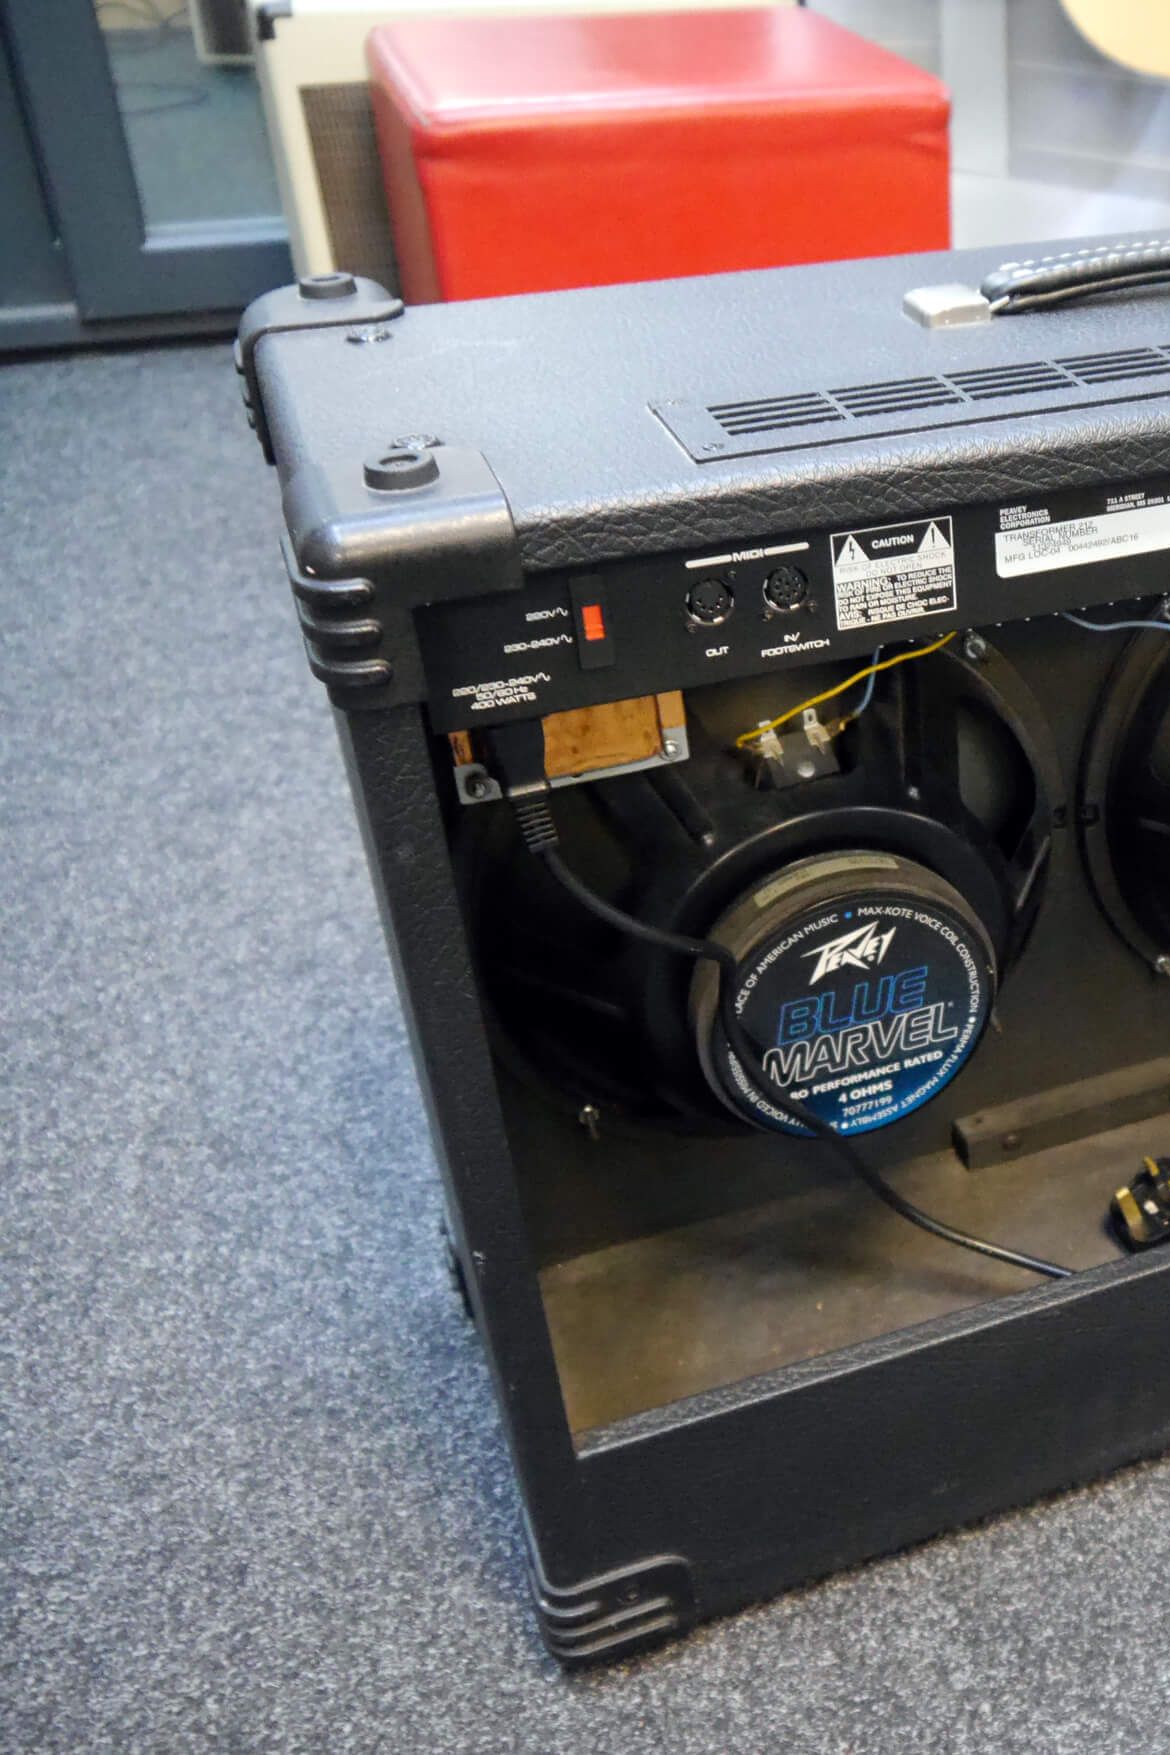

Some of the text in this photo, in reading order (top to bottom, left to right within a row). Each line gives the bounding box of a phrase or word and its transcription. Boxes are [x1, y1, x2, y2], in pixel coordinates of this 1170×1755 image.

[999, 505, 1027, 517] PEAVEY
[999, 509, 1050, 523] ELECTRONICS
[999, 516, 1051, 530] CORPORATION
[1003, 522, 1076, 542] TRANSFORMER
[1058, 526, 1098, 540] NUMBER
[871, 534, 915, 549] CAUTION
[731, 548, 764, 563] MIDI
[875, 557, 914, 569] ELECTRIC
[918, 551, 946, 561] SHOCK
[1003, 553, 1026, 564] MFG
[705, 646, 729, 658] OUT
[761, 638, 830, 658] FOOTSWITCH
[470, 692, 537, 710] 400 WATTS
[803, 914, 839, 935] MUSIC
[755, 930, 804, 975] AMERICAN
[800, 920, 897, 986] PEAVEY
[857, 906, 980, 1013] MAX-KOTE VOICE COIL CONSTRUCTION
[745, 973, 758, 988] OF
[778, 966, 929, 1046] BLUE
[762, 1002, 959, 1088] MARVEL
[812, 1062, 900, 1095] PERFORMANCE
[903, 1050, 943, 1069] RATED
[851, 1023, 975, 1128] PERMA FLUX MAGNET ASSEMBLY
[838, 1080, 893, 1104] 4 OHMS
[756, 1100, 789, 1122] VOICED
[842, 1095, 893, 1117] 70777199
